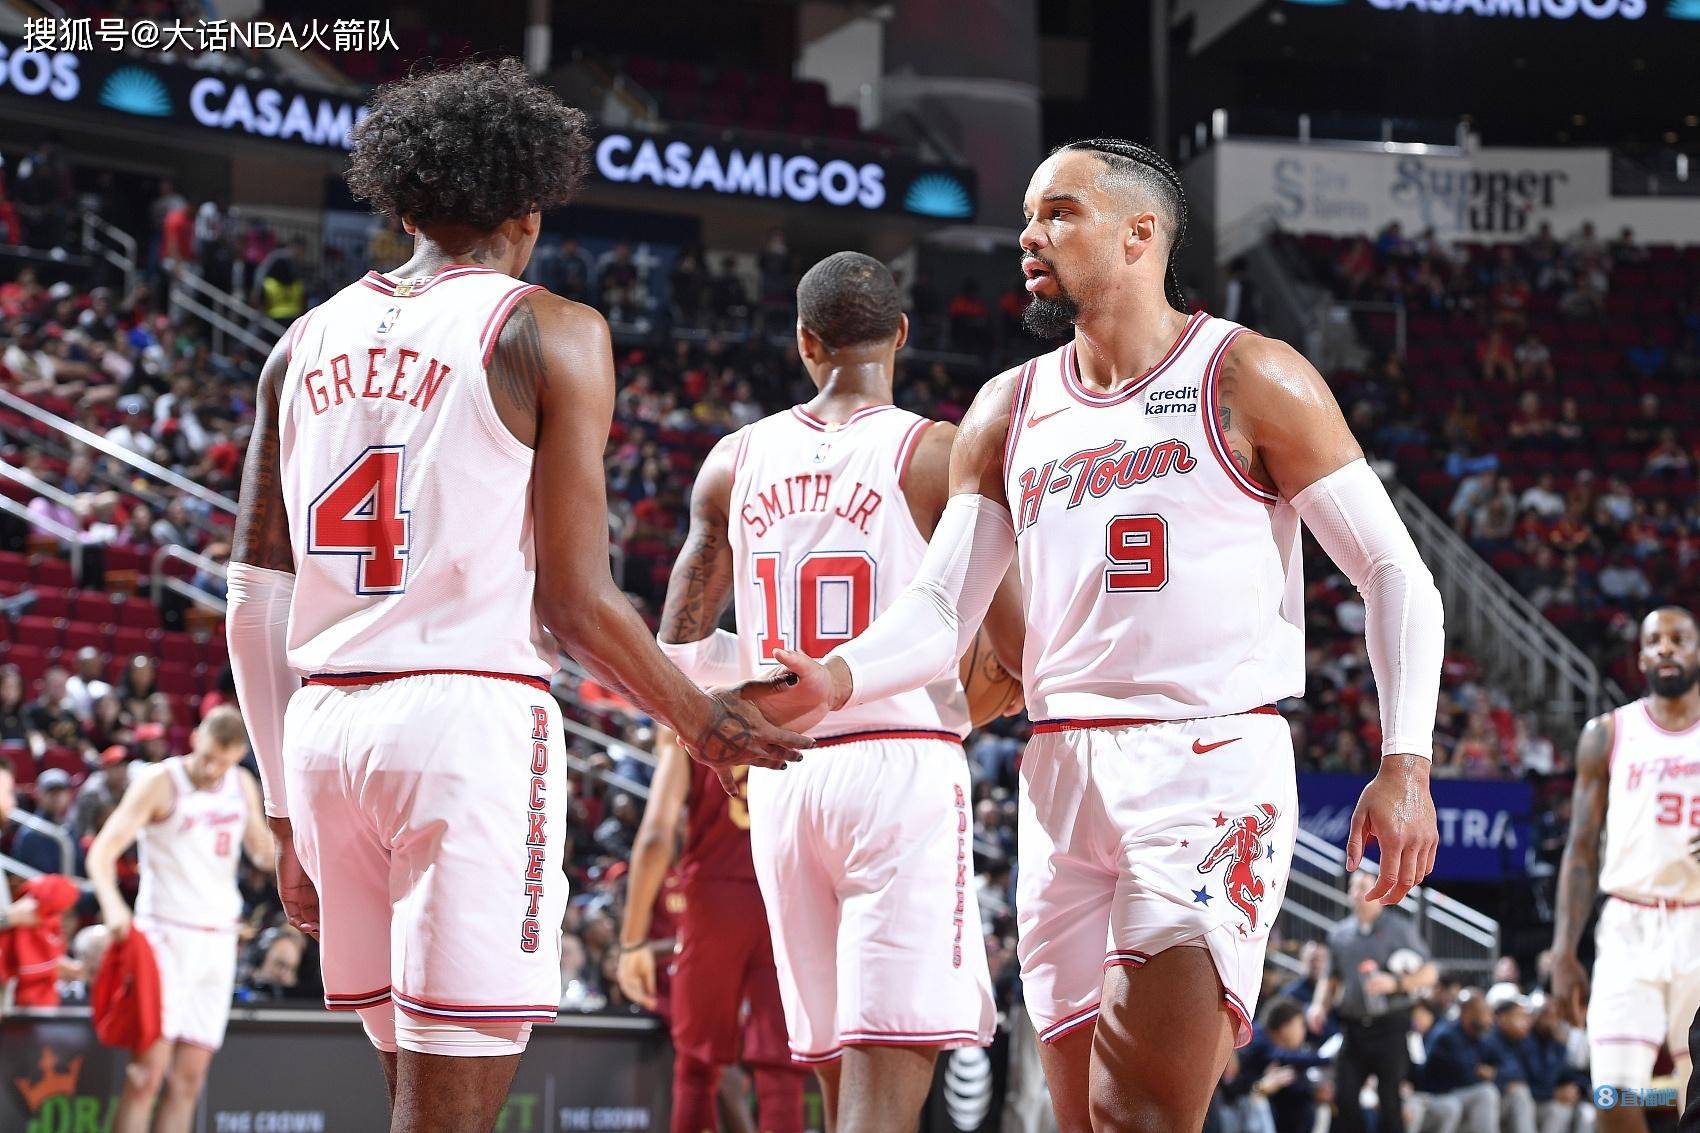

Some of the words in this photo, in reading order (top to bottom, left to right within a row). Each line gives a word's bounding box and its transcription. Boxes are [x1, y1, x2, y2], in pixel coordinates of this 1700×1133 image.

[0, 44, 81, 101] OS
[596, 133, 887, 210] CASAMIGOS
[1389, 155, 1569, 209] Supper
[305, 348, 451, 416] GREEN
[1144, 402, 1197, 416] karma
[1149, 386, 1199, 401] credit
[307, 444, 411, 595] 4
[741, 474, 832, 538] SMITH
[836, 482, 882, 536] JR.
[1016, 438, 1198, 537] H-Town
[1105, 512, 1169, 593] 9
[752, 550, 877, 665] 10
[520, 706, 549, 953] ROCKETS
[1438, 807, 1518, 850] TRA
